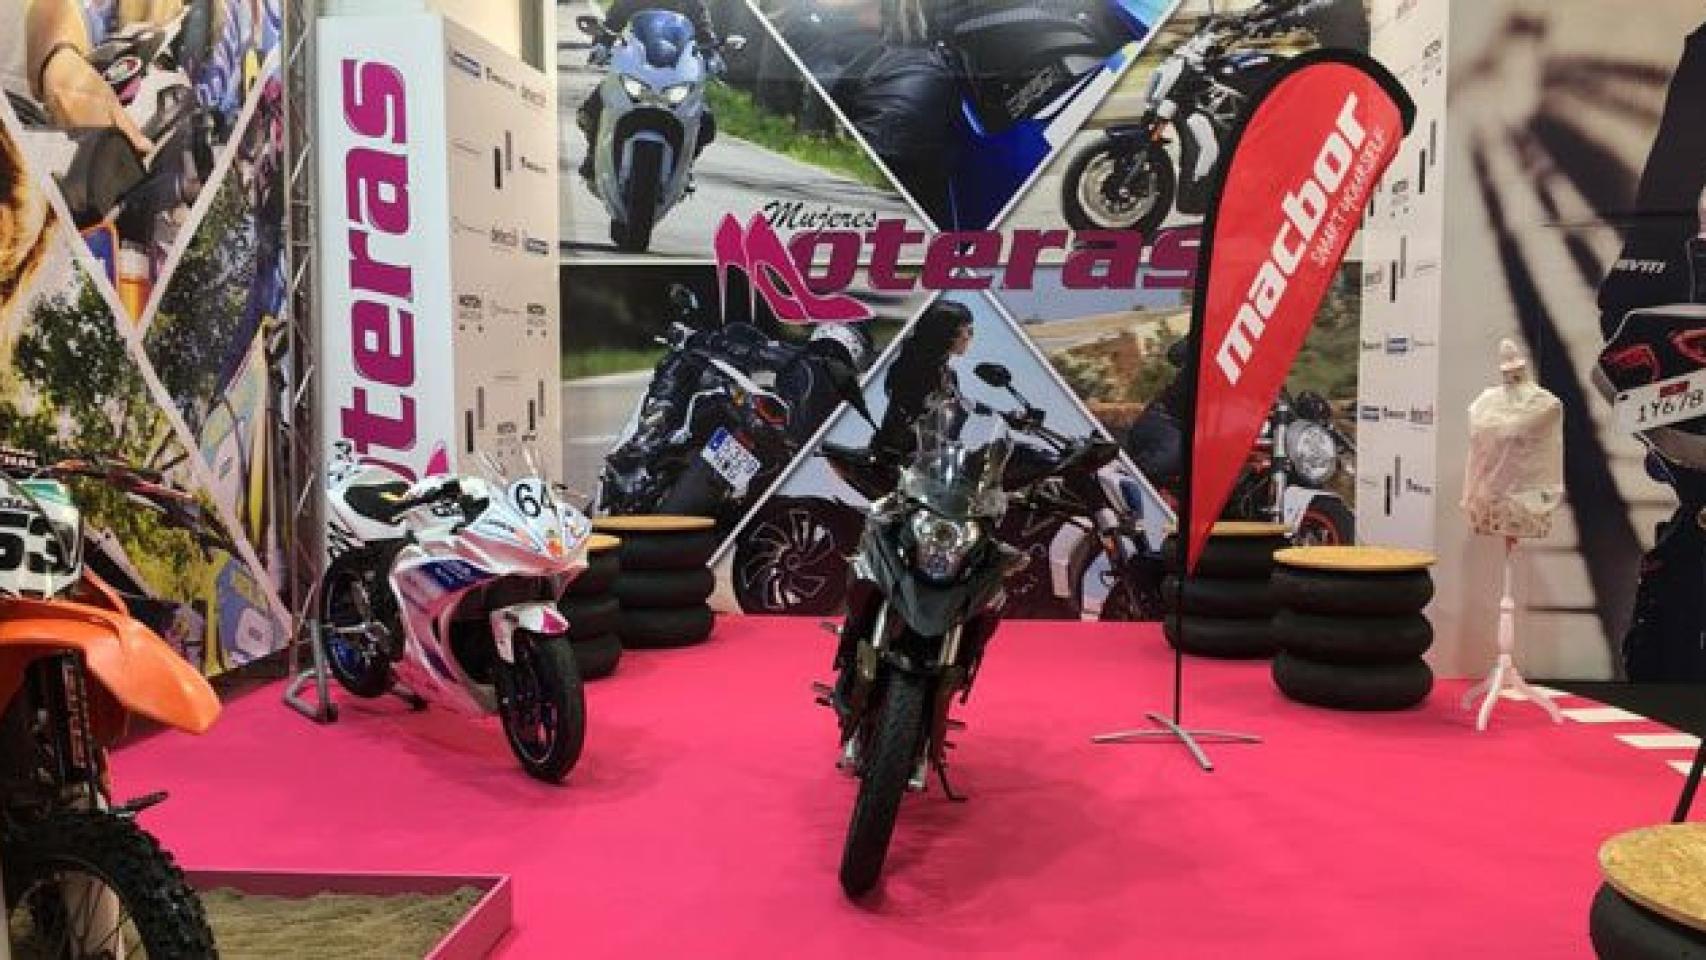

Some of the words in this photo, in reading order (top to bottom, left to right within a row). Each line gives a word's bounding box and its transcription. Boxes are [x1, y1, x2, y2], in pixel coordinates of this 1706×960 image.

[338, 58, 417, 485] teras
[763, 199, 877, 239] Mujeres
[1216, 91, 1366, 385] macbor
